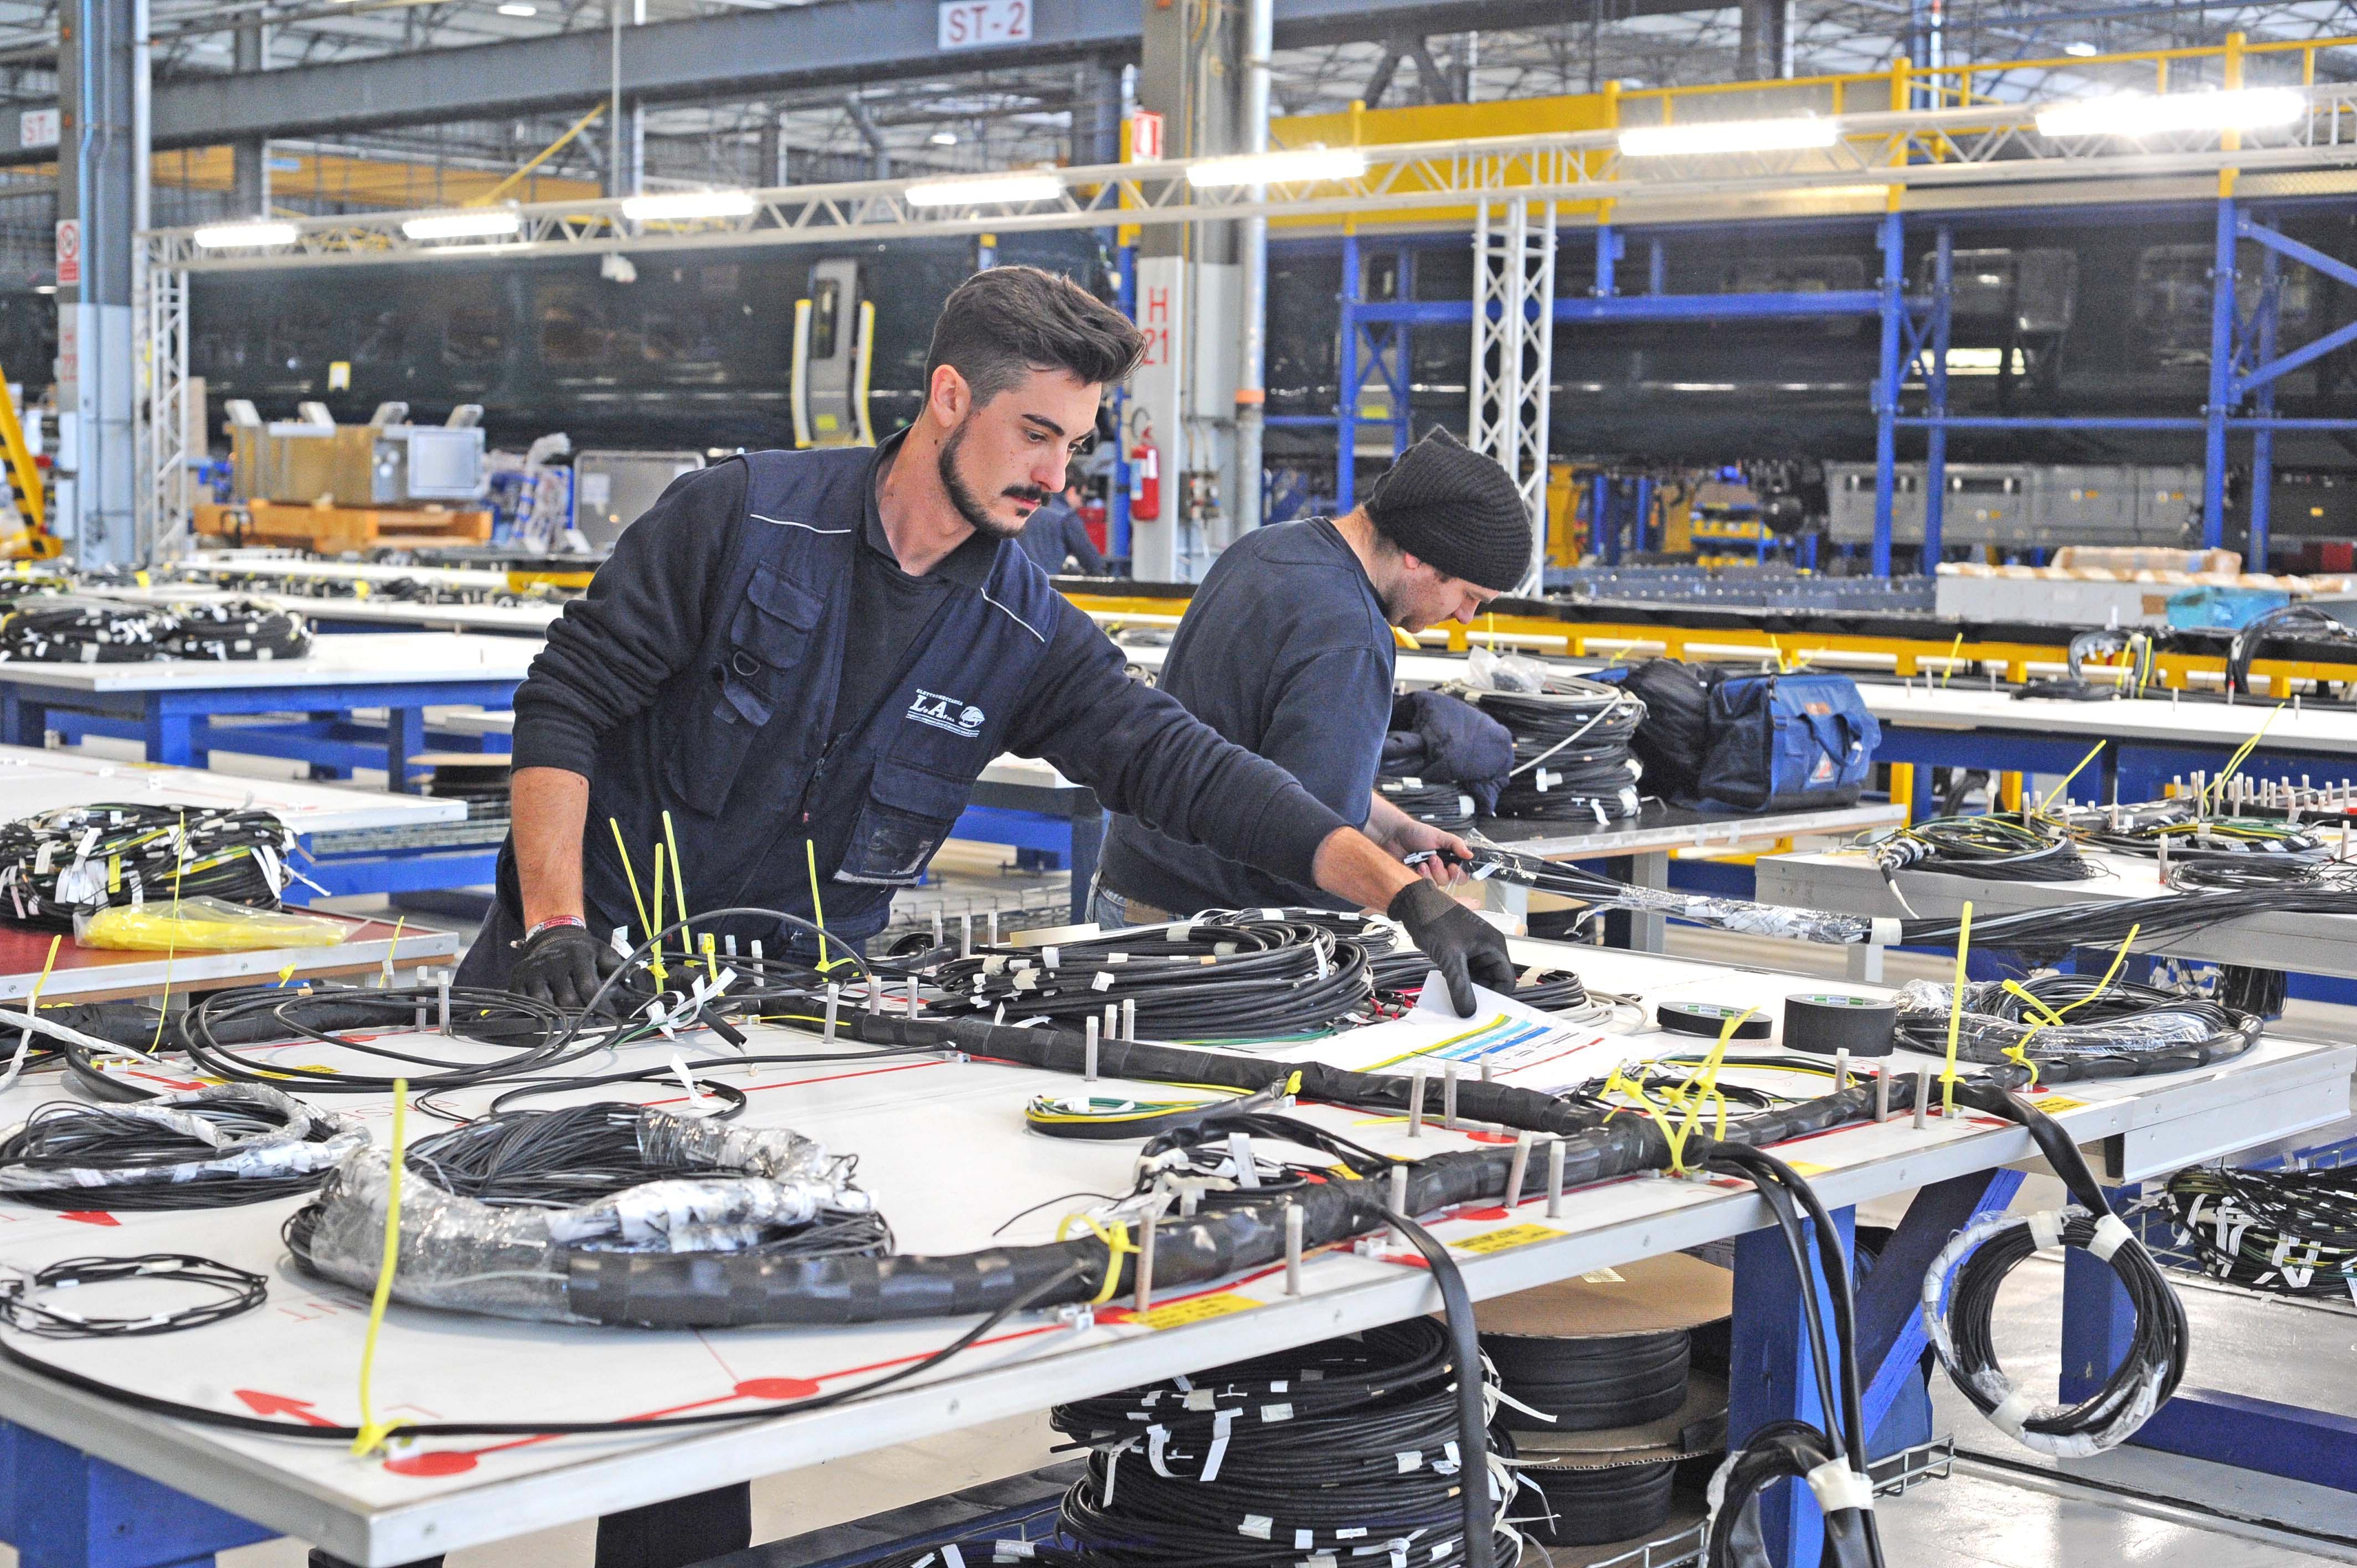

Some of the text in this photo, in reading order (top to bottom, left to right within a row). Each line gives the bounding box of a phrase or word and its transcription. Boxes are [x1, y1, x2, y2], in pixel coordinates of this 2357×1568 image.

[948, 1, 1026, 43] ST-2
[1148, 286, 1169, 322] H
[1143, 327, 1169, 365] 21
